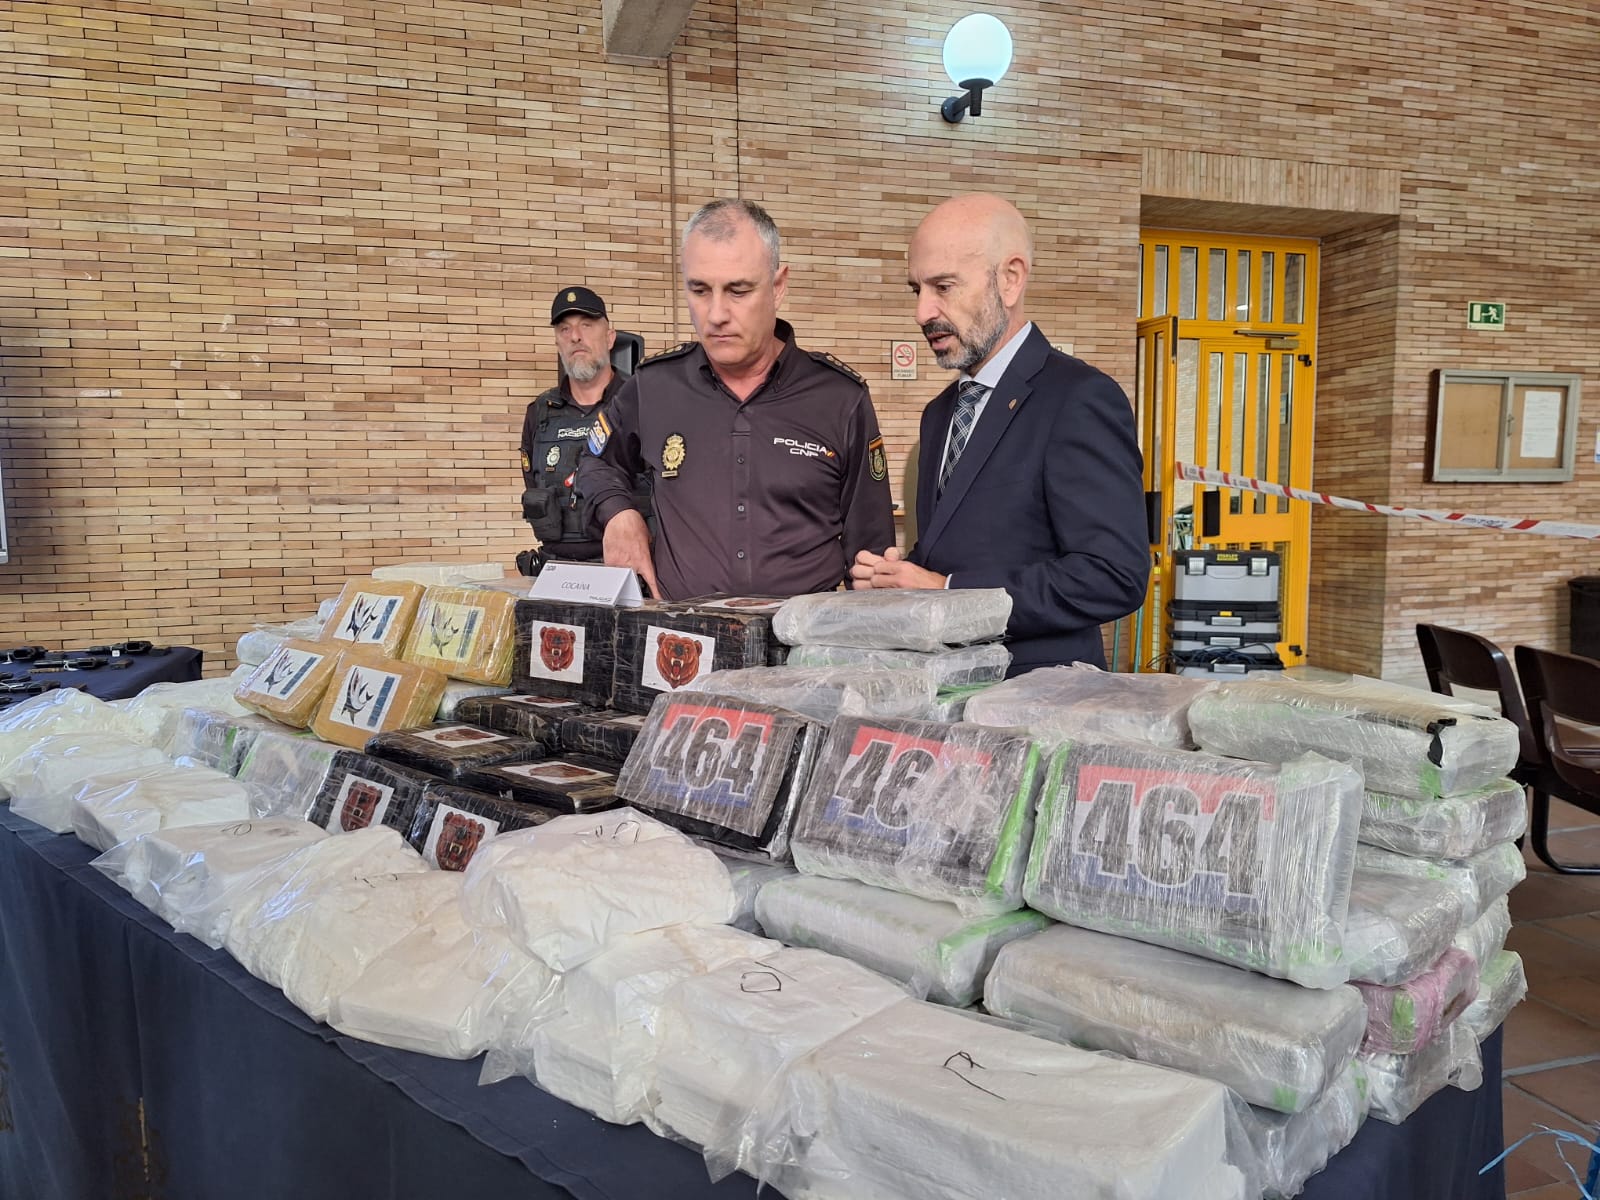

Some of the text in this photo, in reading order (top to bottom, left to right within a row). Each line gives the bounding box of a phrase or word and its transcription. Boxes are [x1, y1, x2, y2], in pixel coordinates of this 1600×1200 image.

[773, 437, 827, 454] POLICIA
[789, 447, 819, 457] CNP
[561, 581, 591, 591] COCAINA
[651, 714, 767, 797] 464
[1074, 779, 1265, 897] 464
